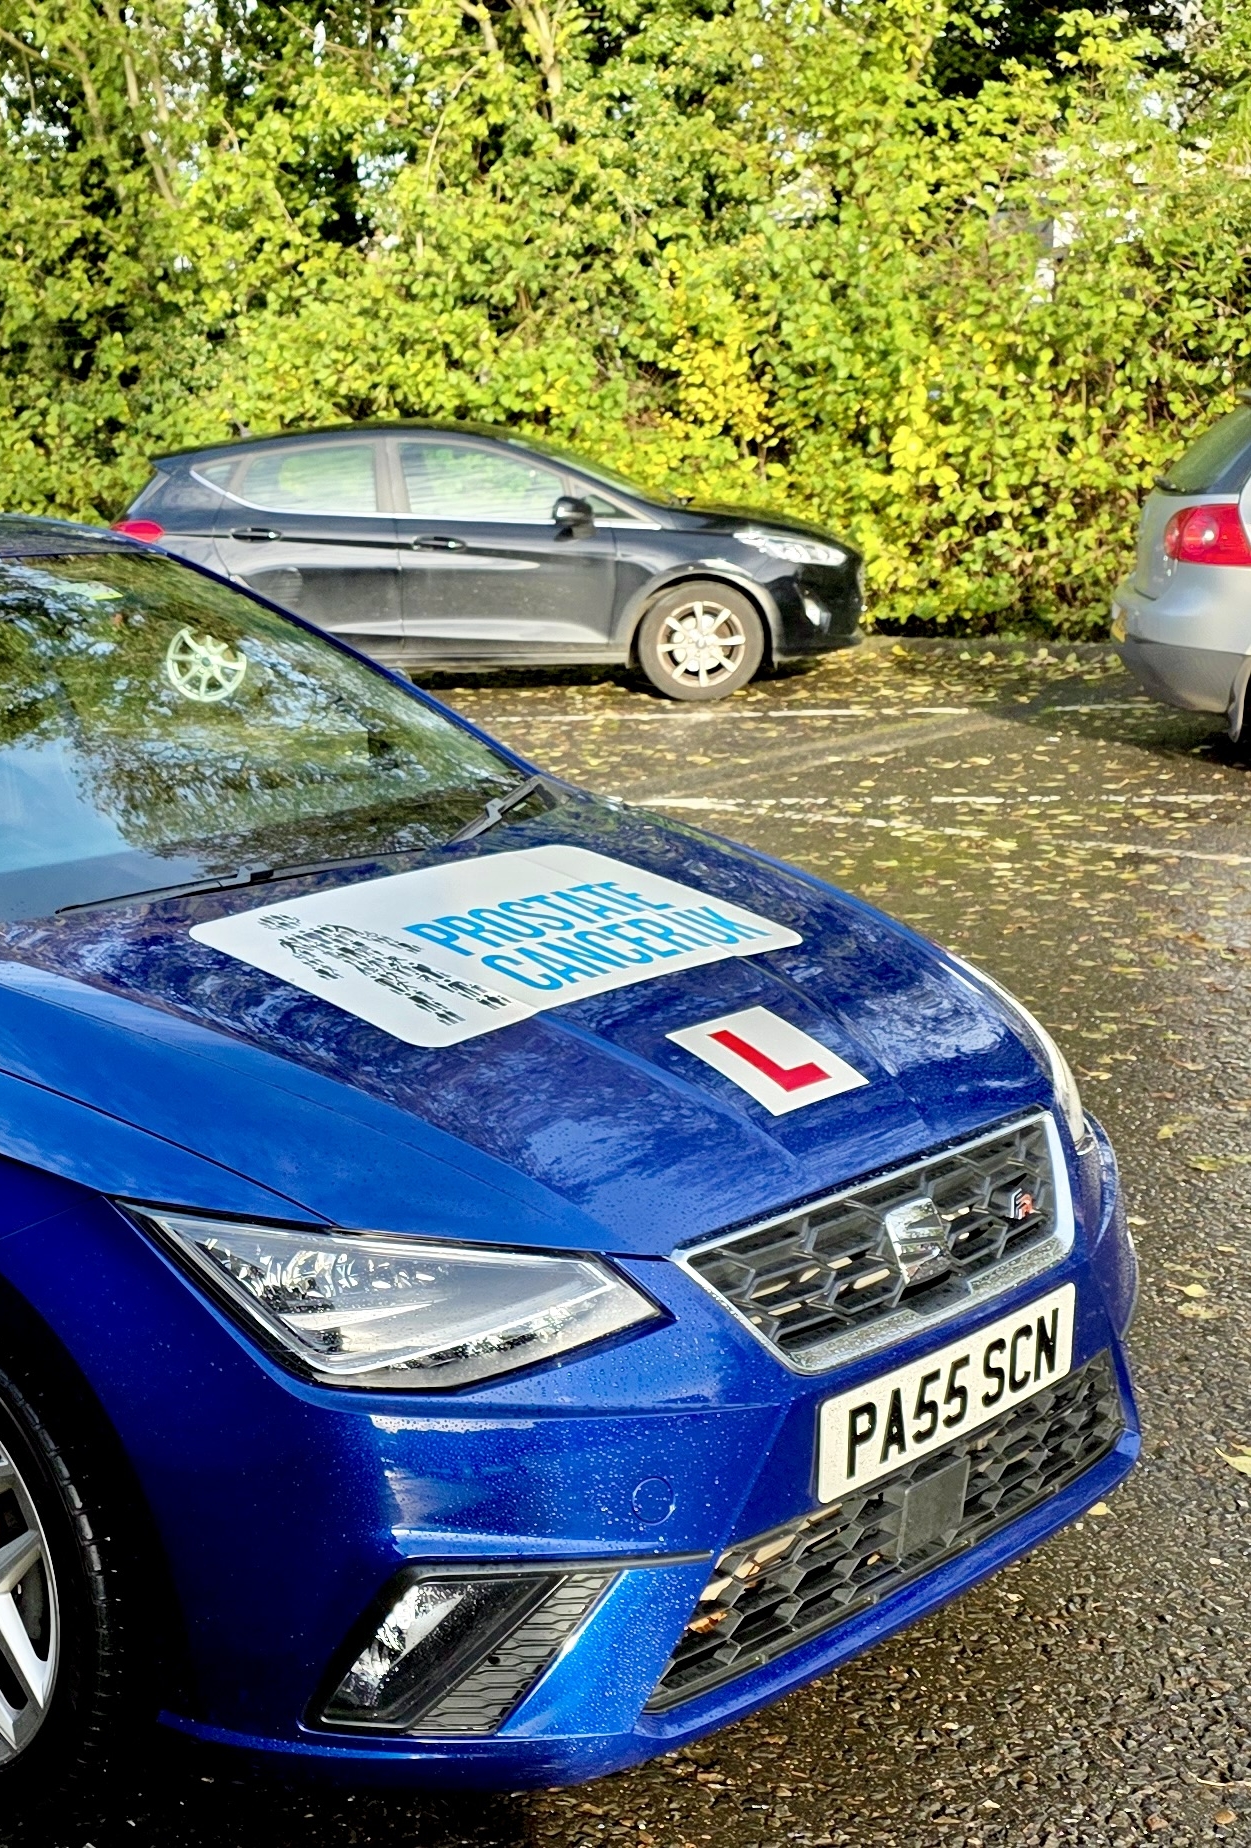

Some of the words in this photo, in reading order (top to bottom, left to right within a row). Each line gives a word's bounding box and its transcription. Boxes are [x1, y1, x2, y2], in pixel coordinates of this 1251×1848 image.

[402, 881, 677, 957] PROSTATE
[707, 1029, 832, 1093] L
[981, 1307, 1060, 1408] SCN
